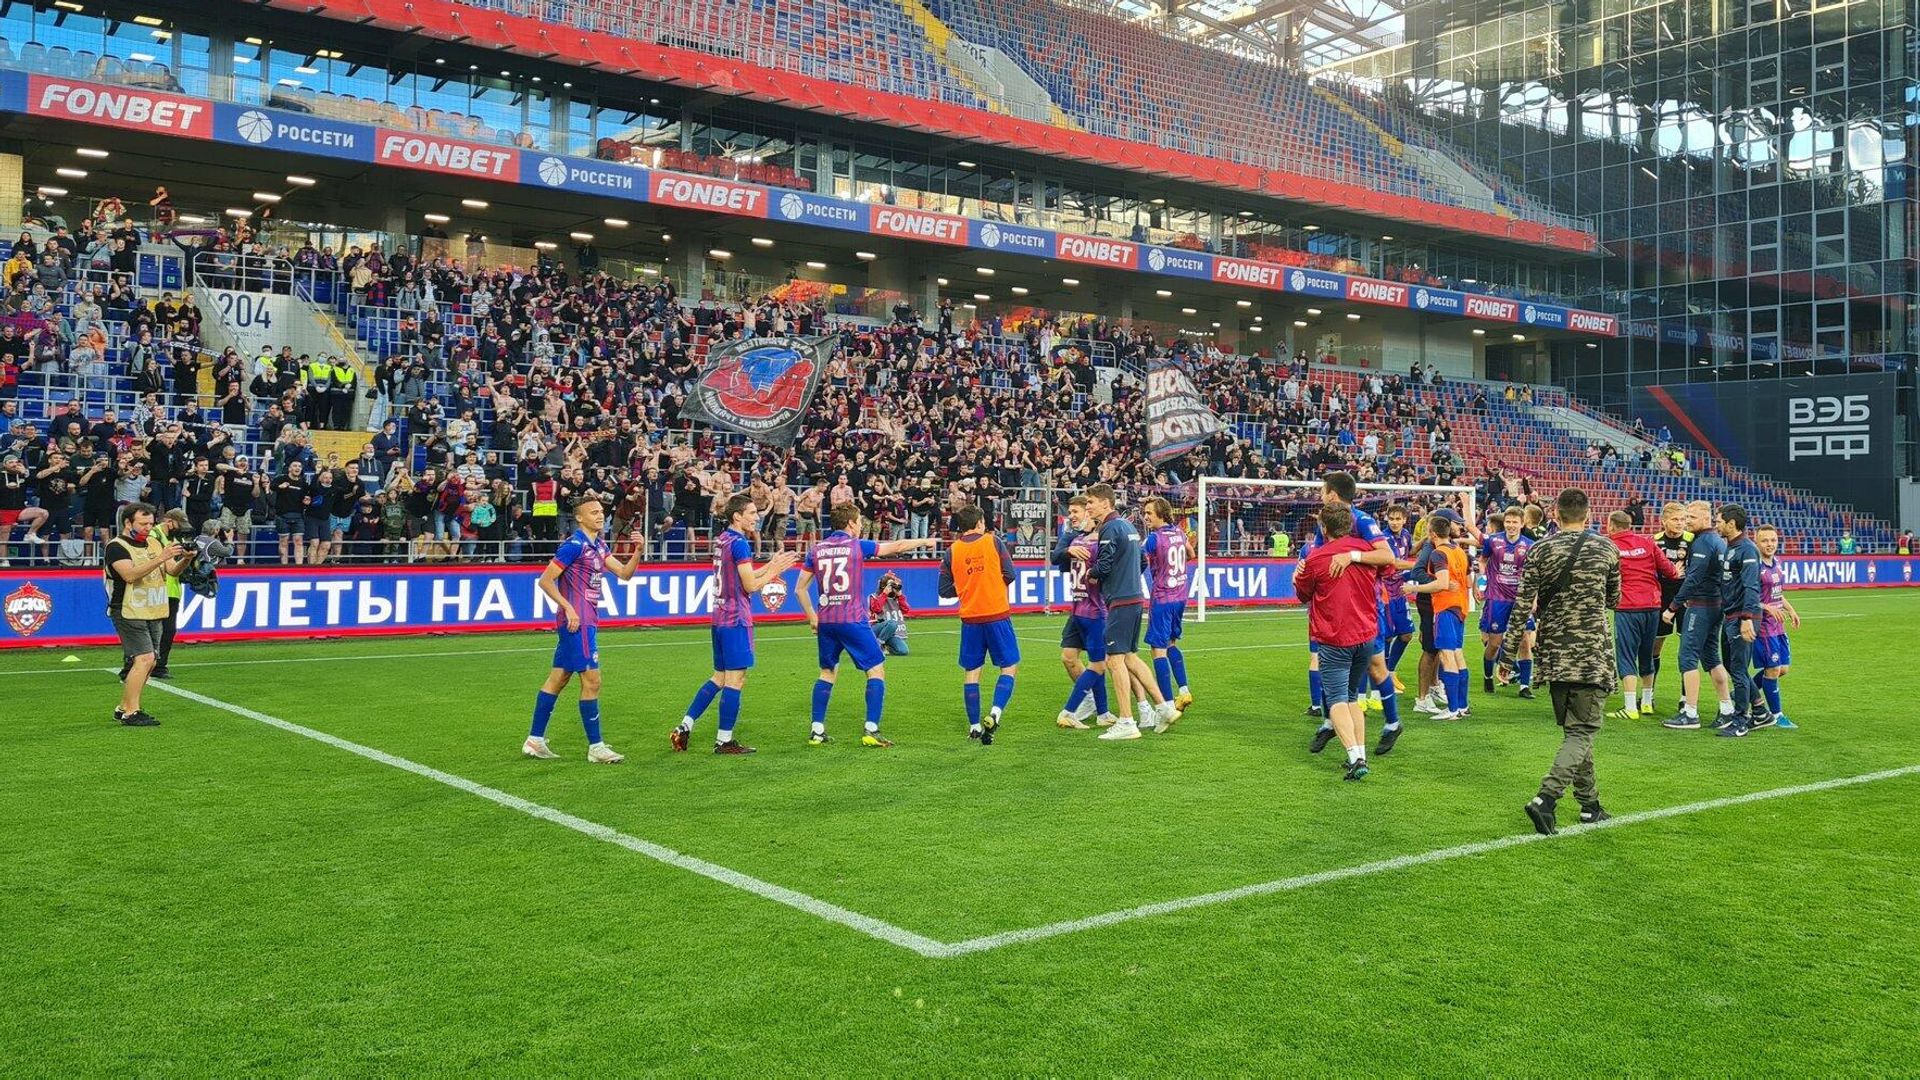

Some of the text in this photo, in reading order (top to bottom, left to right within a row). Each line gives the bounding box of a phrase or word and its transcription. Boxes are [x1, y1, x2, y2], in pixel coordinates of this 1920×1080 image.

[40, 84, 202, 130] FONBET
[278, 123, 354, 148] РОССЕТИ
[382, 135, 511, 174] FONBET
[571, 169, 632, 189] РОССЕТИ
[657, 178, 761, 211] FONBET
[806, 203, 856, 221] РОССЕТИ
[876, 211, 963, 240] FONBET
[1002, 231, 1045, 248] РОССЕТИ
[1060, 237, 1133, 263] FONBET
[1167, 256, 1203, 271] РОССЕТИ
[1217, 261, 1279, 285] FONBET
[1306, 277, 1339, 291] РОССЕТИ
[1350, 281, 1404, 303] FONBET
[218, 293, 271, 329] 204
[1430, 295, 1458, 308] РОССЕТИ
[1467, 299, 1514, 318] FONBET
[1537, 311, 1562, 323] РОССЕТИ
[1570, 313, 1614, 332] FONBET
[1789, 395, 1870, 424] ВЭБ
[1789, 434, 1870, 461] РФ
[1168, 545, 1186, 576] 90
[1804, 561, 1856, 583] МАТЧИ
[818, 557, 849, 593] 73
[1188, 567, 1267, 598] АТЧИ
[8, 597, 47, 614] ЦСКА
[132, 585, 168, 608] СМ
[176, 579, 408, 628] ИЛЕТЫ
[432, 578, 514, 622] НА
